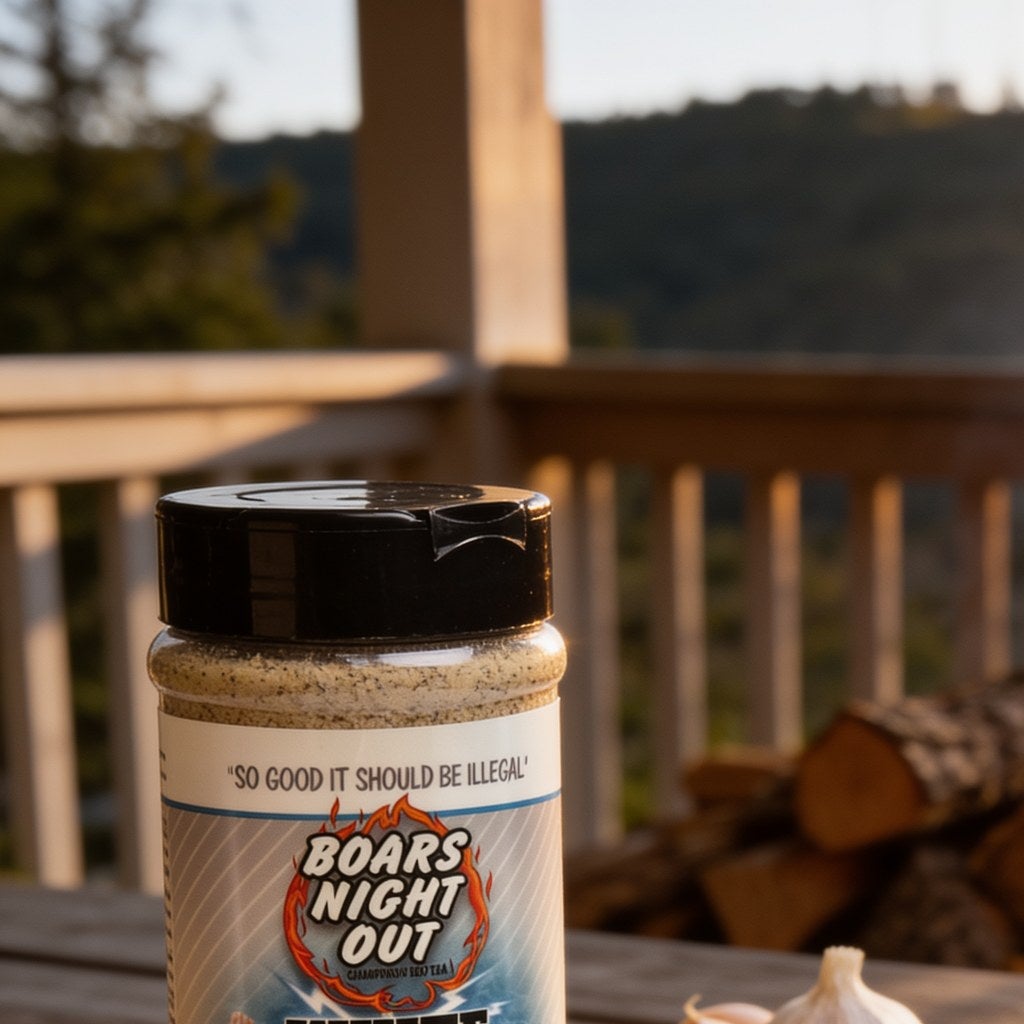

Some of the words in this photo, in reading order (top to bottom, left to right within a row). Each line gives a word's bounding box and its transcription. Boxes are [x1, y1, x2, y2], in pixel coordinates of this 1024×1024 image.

[265, 766, 323, 792] GOOD
[330, 767, 349, 792] IT
[356, 764, 433, 792] SHOULD
[439, 763, 462, 787] BE
[301, 828, 470, 878] BOARS
[310, 874, 466, 922] NIGHT
[340, 918, 440, 967] OUT
